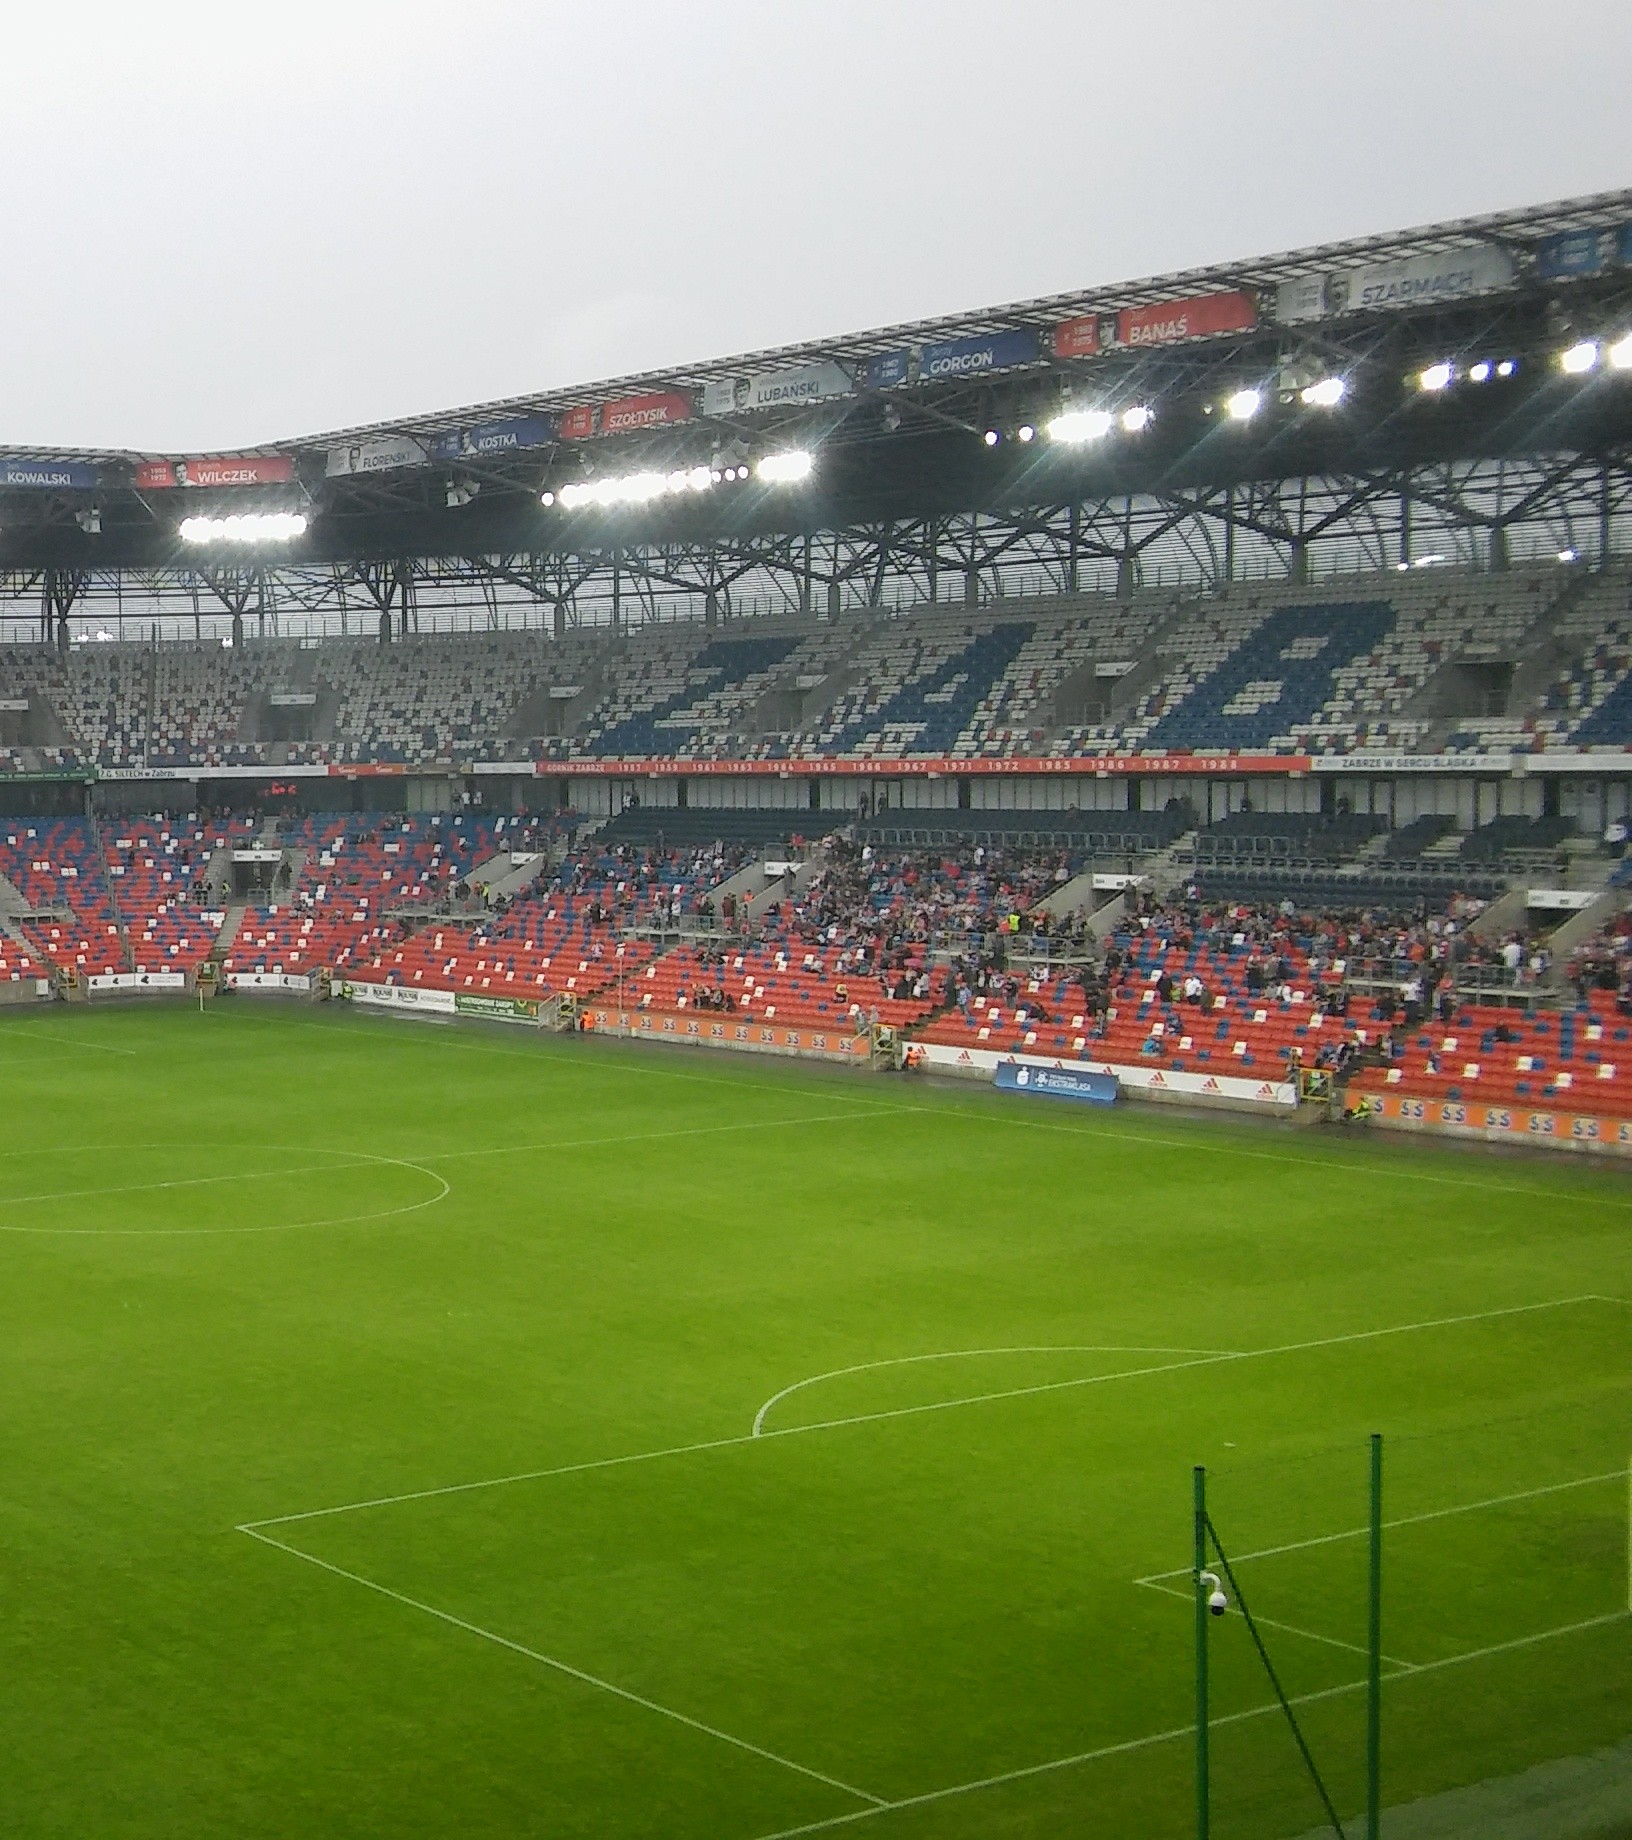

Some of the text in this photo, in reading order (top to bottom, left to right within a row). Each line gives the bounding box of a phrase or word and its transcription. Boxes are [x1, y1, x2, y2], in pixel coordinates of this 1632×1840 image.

[1129, 315, 1188, 344] BANAŚ
[929, 347, 994, 374] GORGOŃ
[756, 381, 820, 403] LUBAŃSKI
[609, 407, 668, 427] SZOŁTYSIK
[478, 432, 518, 449] KOSTKA
[7, 471, 71, 485] KOWALSKI
[197, 470, 259, 483] WILCZEK
[692, 763, 716, 771] 1961
[809, 763, 836, 771] 1965
[852, 763, 881, 771] 1966
[897, 762, 927, 770] 1967
[943, 762, 972, 770] 1971
[988, 762, 1019, 770] 1972
[1038, 761, 1071, 769] 1985
[1090, 760, 1125, 769] 1986
[1145, 760, 1180, 769] 1987
[1201, 760, 1237, 769] 1988
[1342, 759, 1382, 768] ZABRZE
[115, 769, 144, 778] SILTECH
